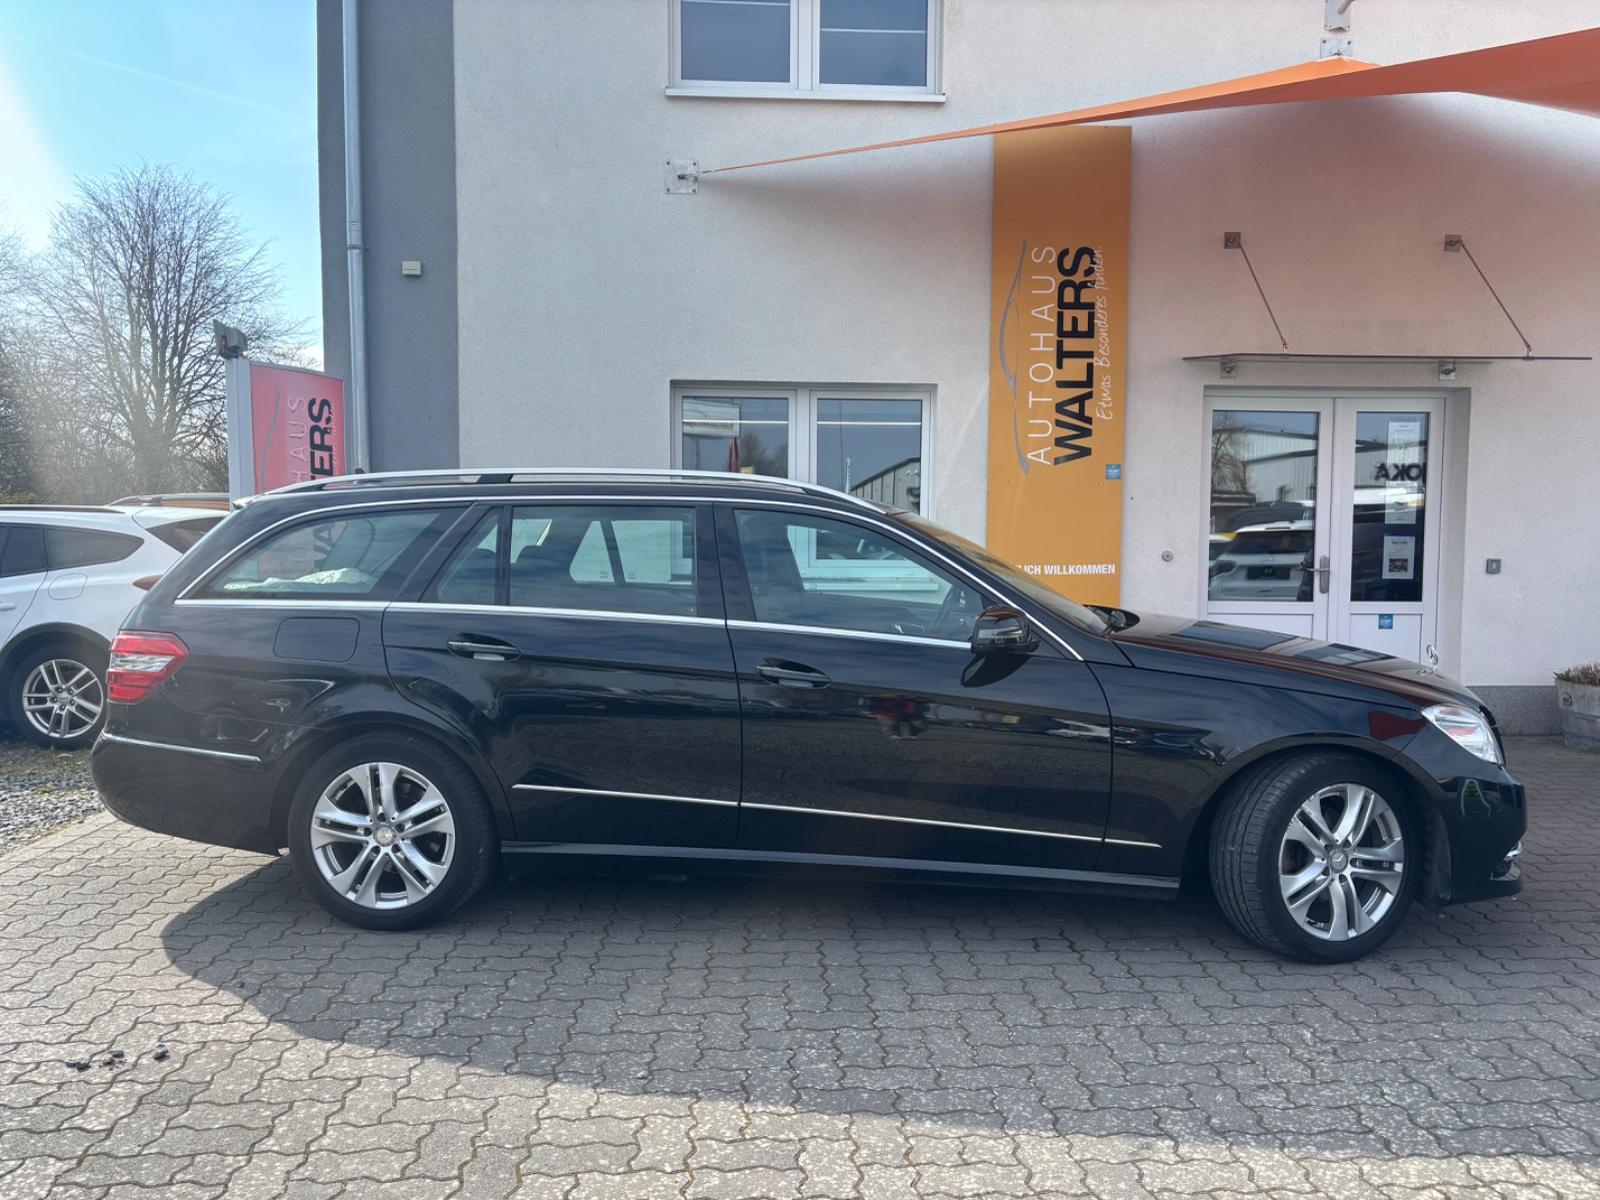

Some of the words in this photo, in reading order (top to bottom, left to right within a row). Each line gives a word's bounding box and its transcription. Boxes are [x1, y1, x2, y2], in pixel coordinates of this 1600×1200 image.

[1027, 246, 1056, 465] AUTOHAUS
[1054, 246, 1096, 466] WALTERS
[1093, 296, 1110, 368] Besonderes
[1095, 373, 1113, 420] Etwas
[308, 398, 333, 480] ERS
[1043, 563, 1116, 575] WILLKOMMEN
